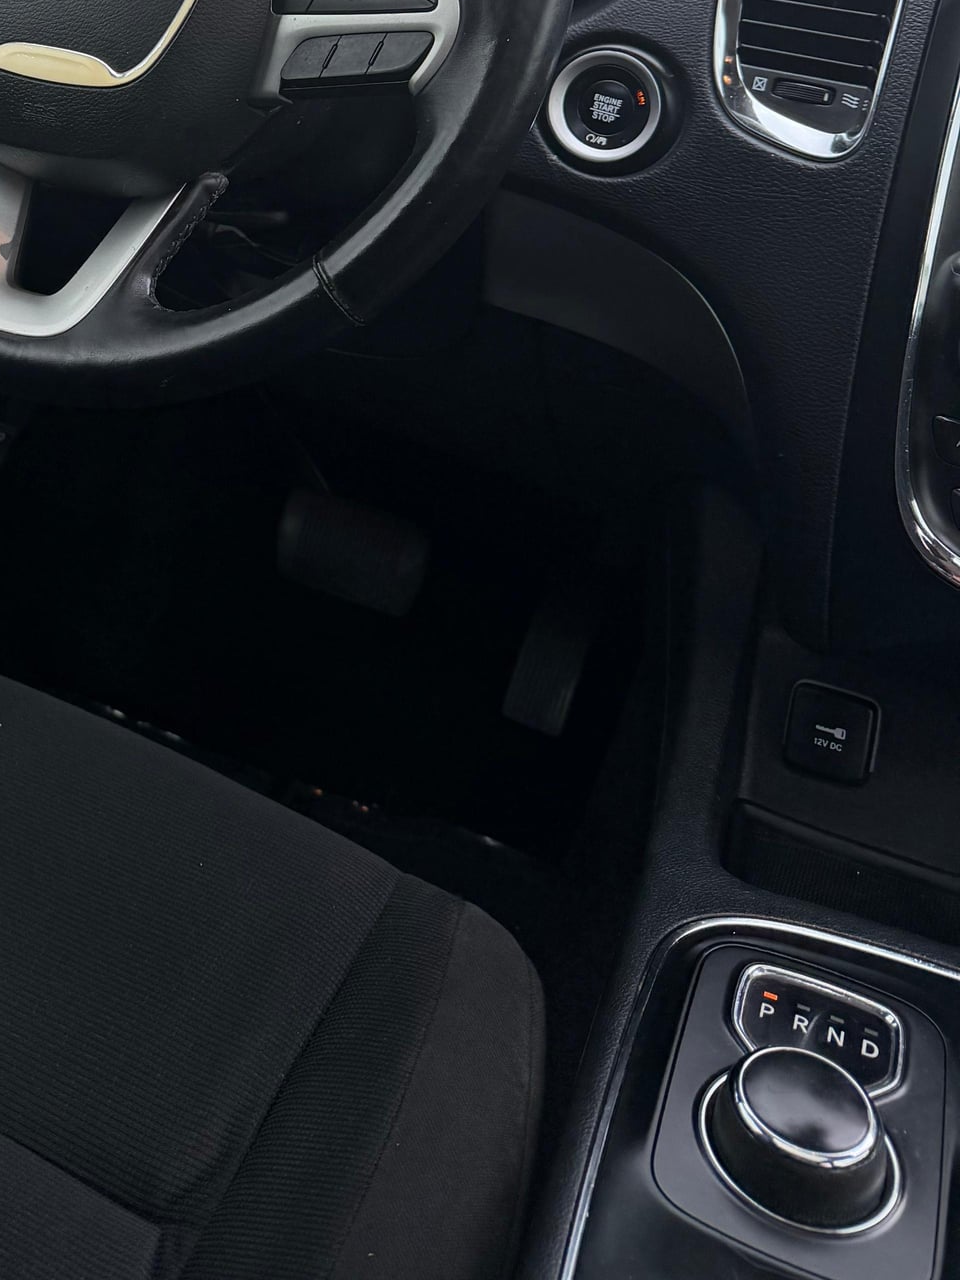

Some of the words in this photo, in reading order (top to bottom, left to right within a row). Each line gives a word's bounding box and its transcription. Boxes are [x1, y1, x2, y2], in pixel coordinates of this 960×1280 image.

[593, 93, 623, 107] ENGINE
[592, 101, 620, 114] START
[591, 111, 616, 123] STOP
[814, 737, 829, 748] 12V
[829, 741, 843, 752] DC
[759, 1002, 775, 1018] P
[792, 1013, 810, 1034] R
[826, 1025, 845, 1048] N
[860, 1038, 880, 1059] D
